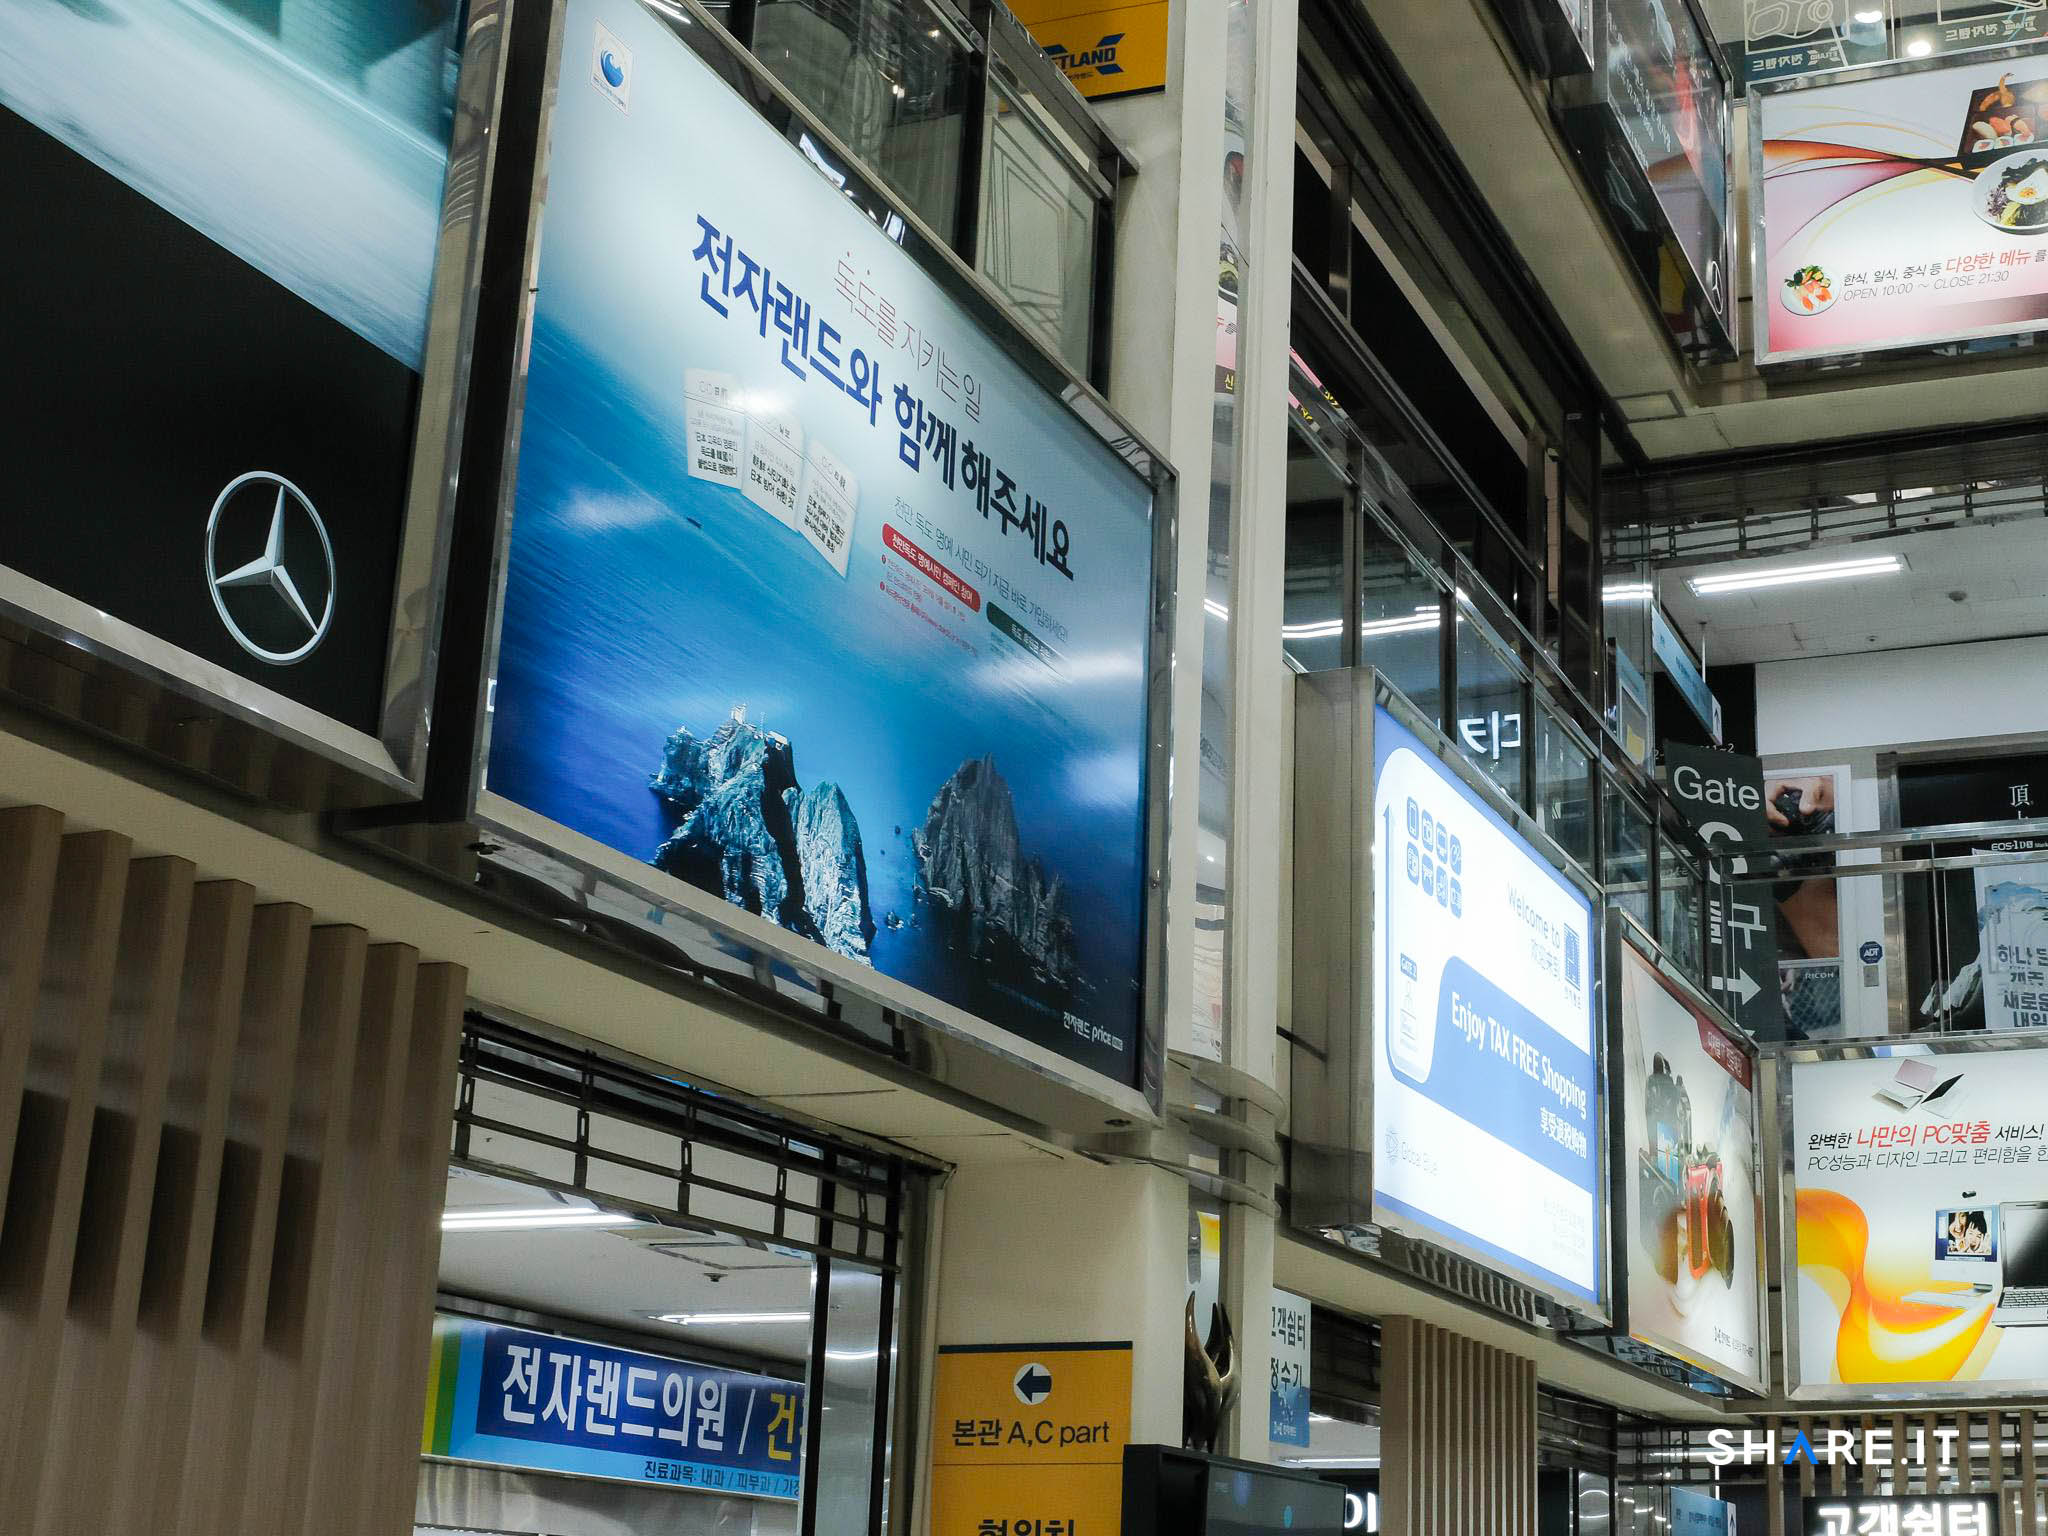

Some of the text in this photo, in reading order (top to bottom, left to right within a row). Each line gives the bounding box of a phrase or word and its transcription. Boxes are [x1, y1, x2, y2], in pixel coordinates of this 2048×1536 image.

[1946, 251, 1997, 273] 다양한
[1999, 249, 2032, 266] 메뉴
[1844, 288, 1878, 301] OPEN
[1883, 283, 1913, 296] 10:00
[1934, 274, 1975, 290] CLOSE
[1979, 271, 2009, 284] 21:30
[834, 259, 898, 349] 독도를
[901, 320, 960, 403] 지키는
[1673, 766, 1760, 811] Gate
[1864, 948, 1879, 957] ADT
[1063, 1011, 1091, 1039] 전자랜드
[1452, 991, 1486, 1050] Enjoy
[1487, 1016, 1511, 1062] TAX
[1512, 1034, 1540, 1081] FREE
[1541, 1055, 1587, 1121] Shopping
[1808, 1120, 2045, 1150] 완벽한 나만의 PC맞춤 서비스!
[1808, 1153, 1872, 1171] PC성능과
[1876, 1151, 1920, 1168] 디자인
[1922, 1149, 1967, 1166] 그리고
[1973, 1145, 2032, 1165] 편리함을
[502, 1344, 727, 1452] 전자랜드의원
[767, 1393, 802, 1462] 건
[952, 1419, 1109, 1448] 본관 A,C part
[645, 1461, 697, 1483] 진료과목:
[701, 1467, 725, 1487] 내과
[737, 1472, 770, 1492] 피부과
